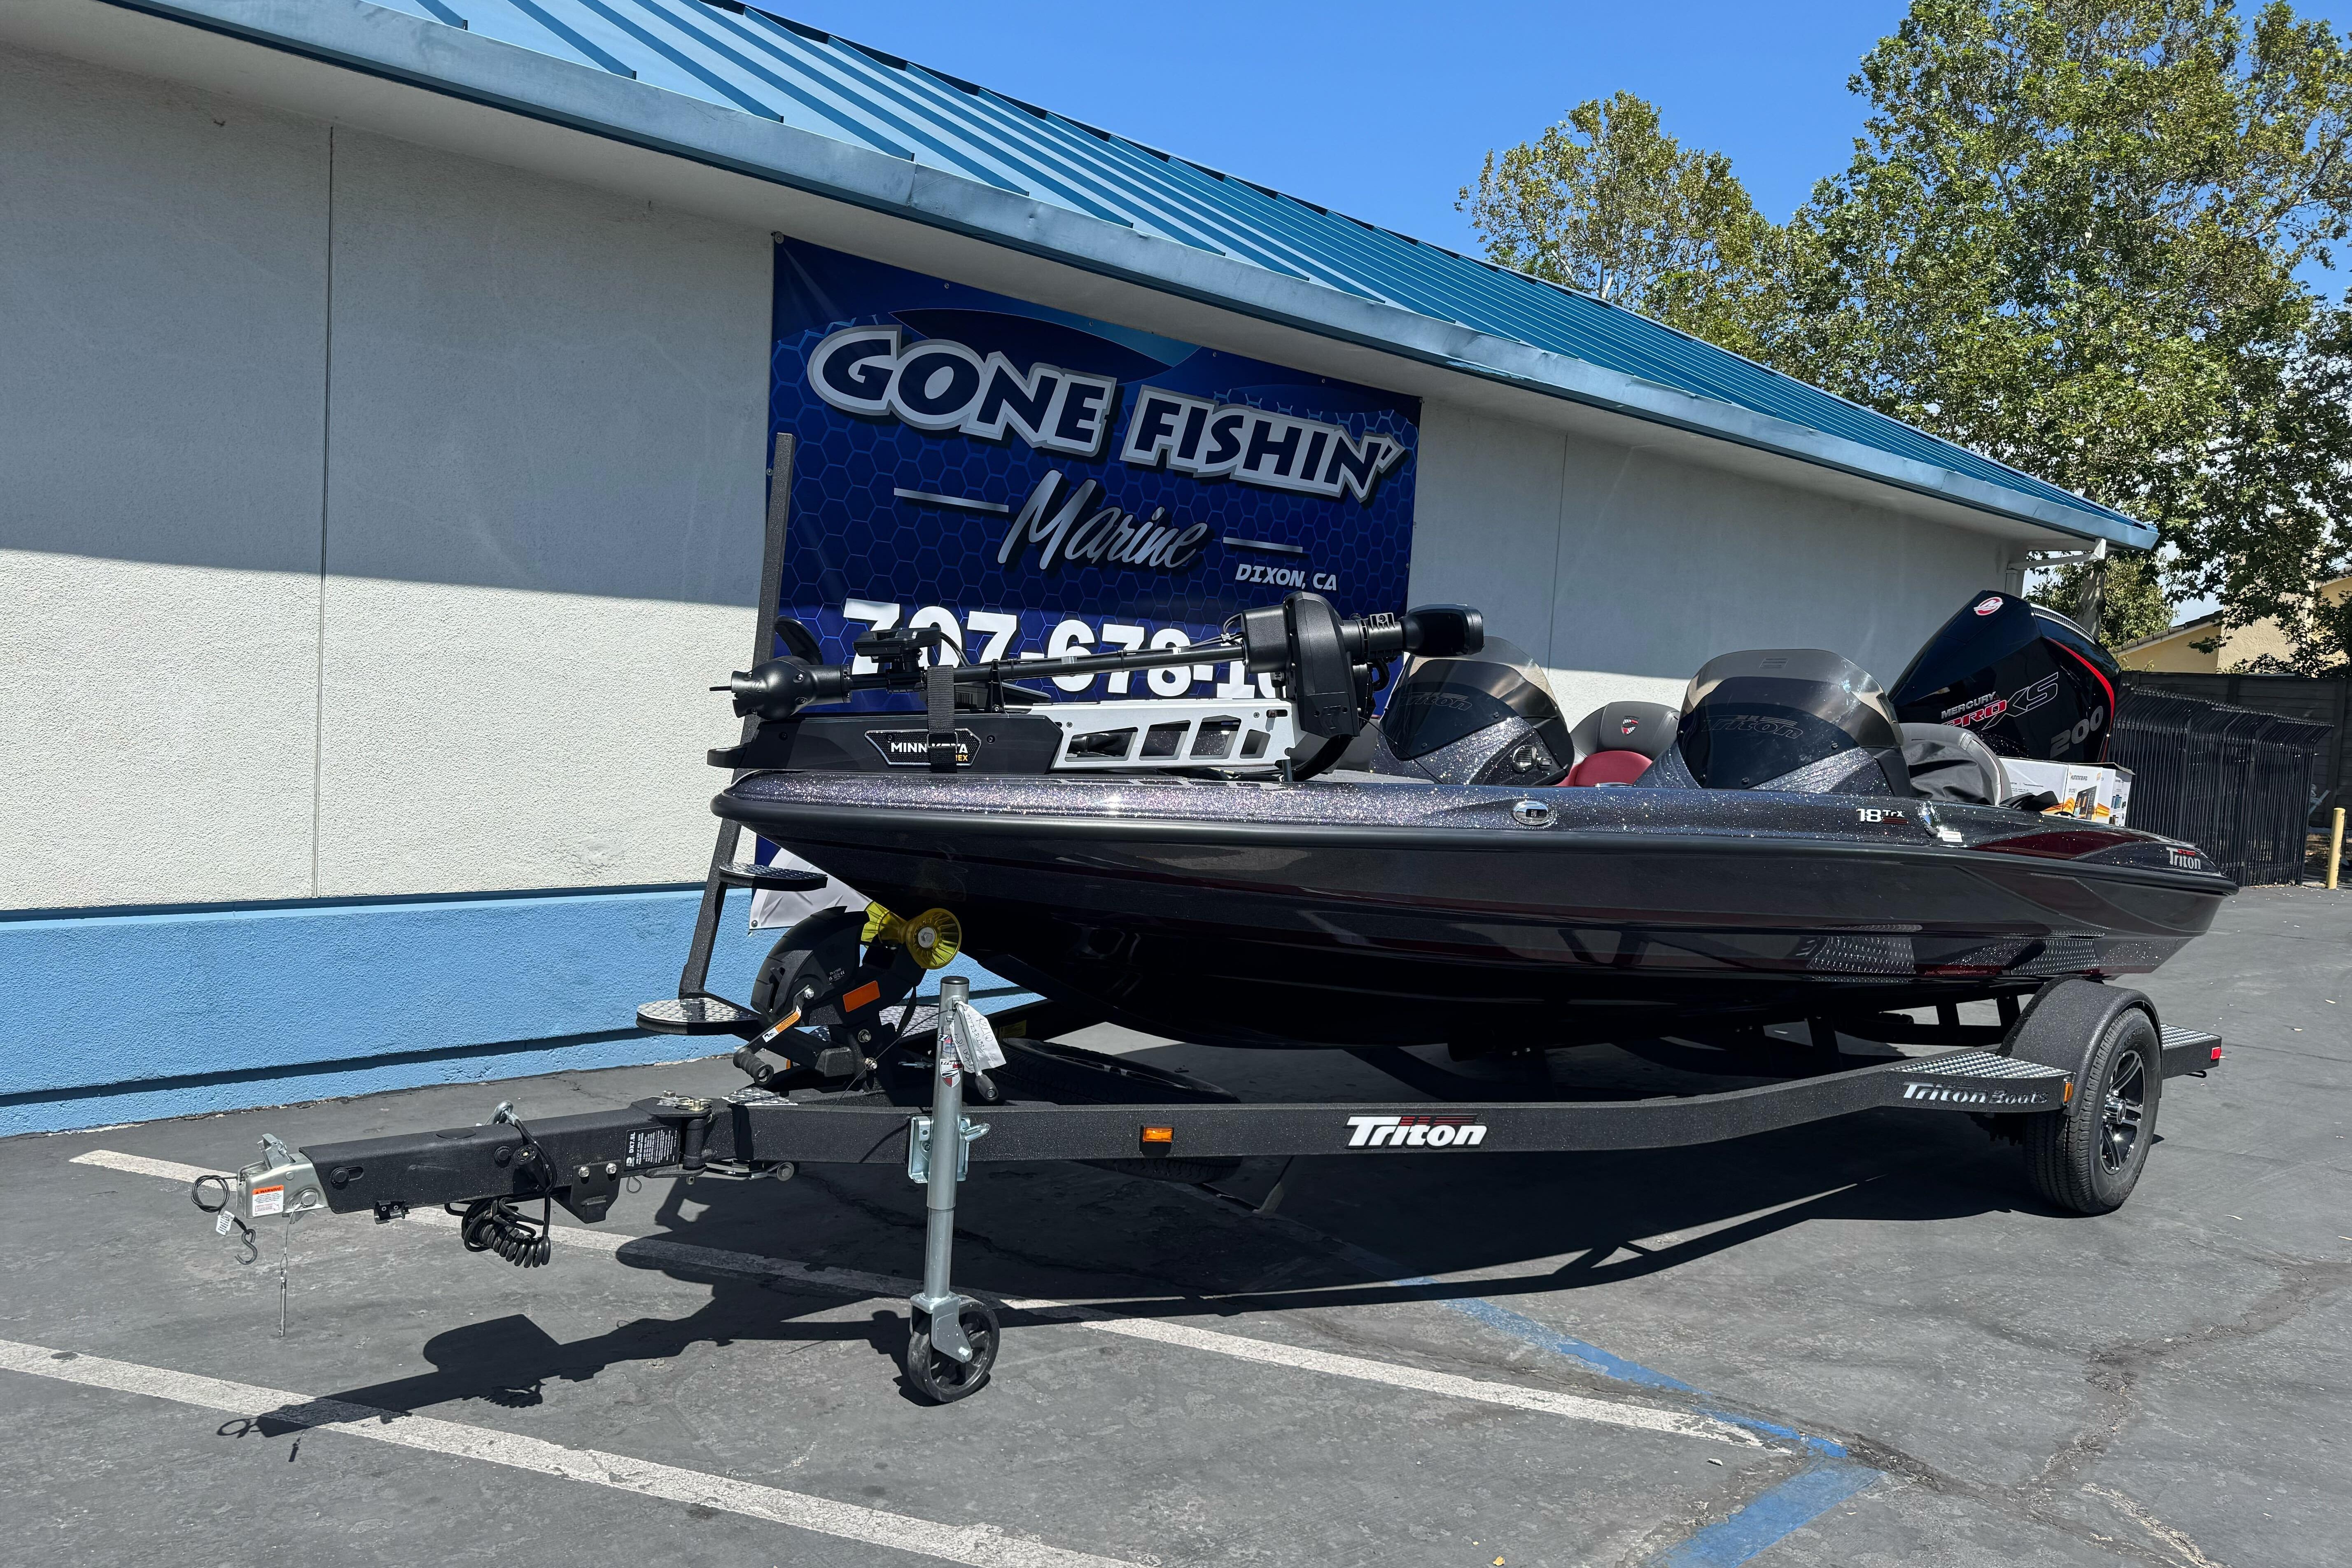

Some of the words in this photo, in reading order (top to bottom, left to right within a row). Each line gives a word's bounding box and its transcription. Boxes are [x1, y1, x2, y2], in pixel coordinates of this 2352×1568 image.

[812, 330, 1113, 452] GONE
[1126, 390, 1400, 497] FISHIN'
[998, 469, 1207, 570] Marine
[1235, 564, 1305, 589] DIXON,
[1312, 574, 1337, 590] CA
[843, 598, 1281, 699] 707-678-1
[1941, 691, 1997, 719] MERCURY
[2050, 706, 2104, 759] 200
[1857, 808, 1882, 822] 18
[2166, 847, 2201, 869] Triton
[1904, 1081, 1988, 1104] Triton
[1989, 1089, 2049, 1104] Boats
[1345, 1115, 1487, 1146] Triton
